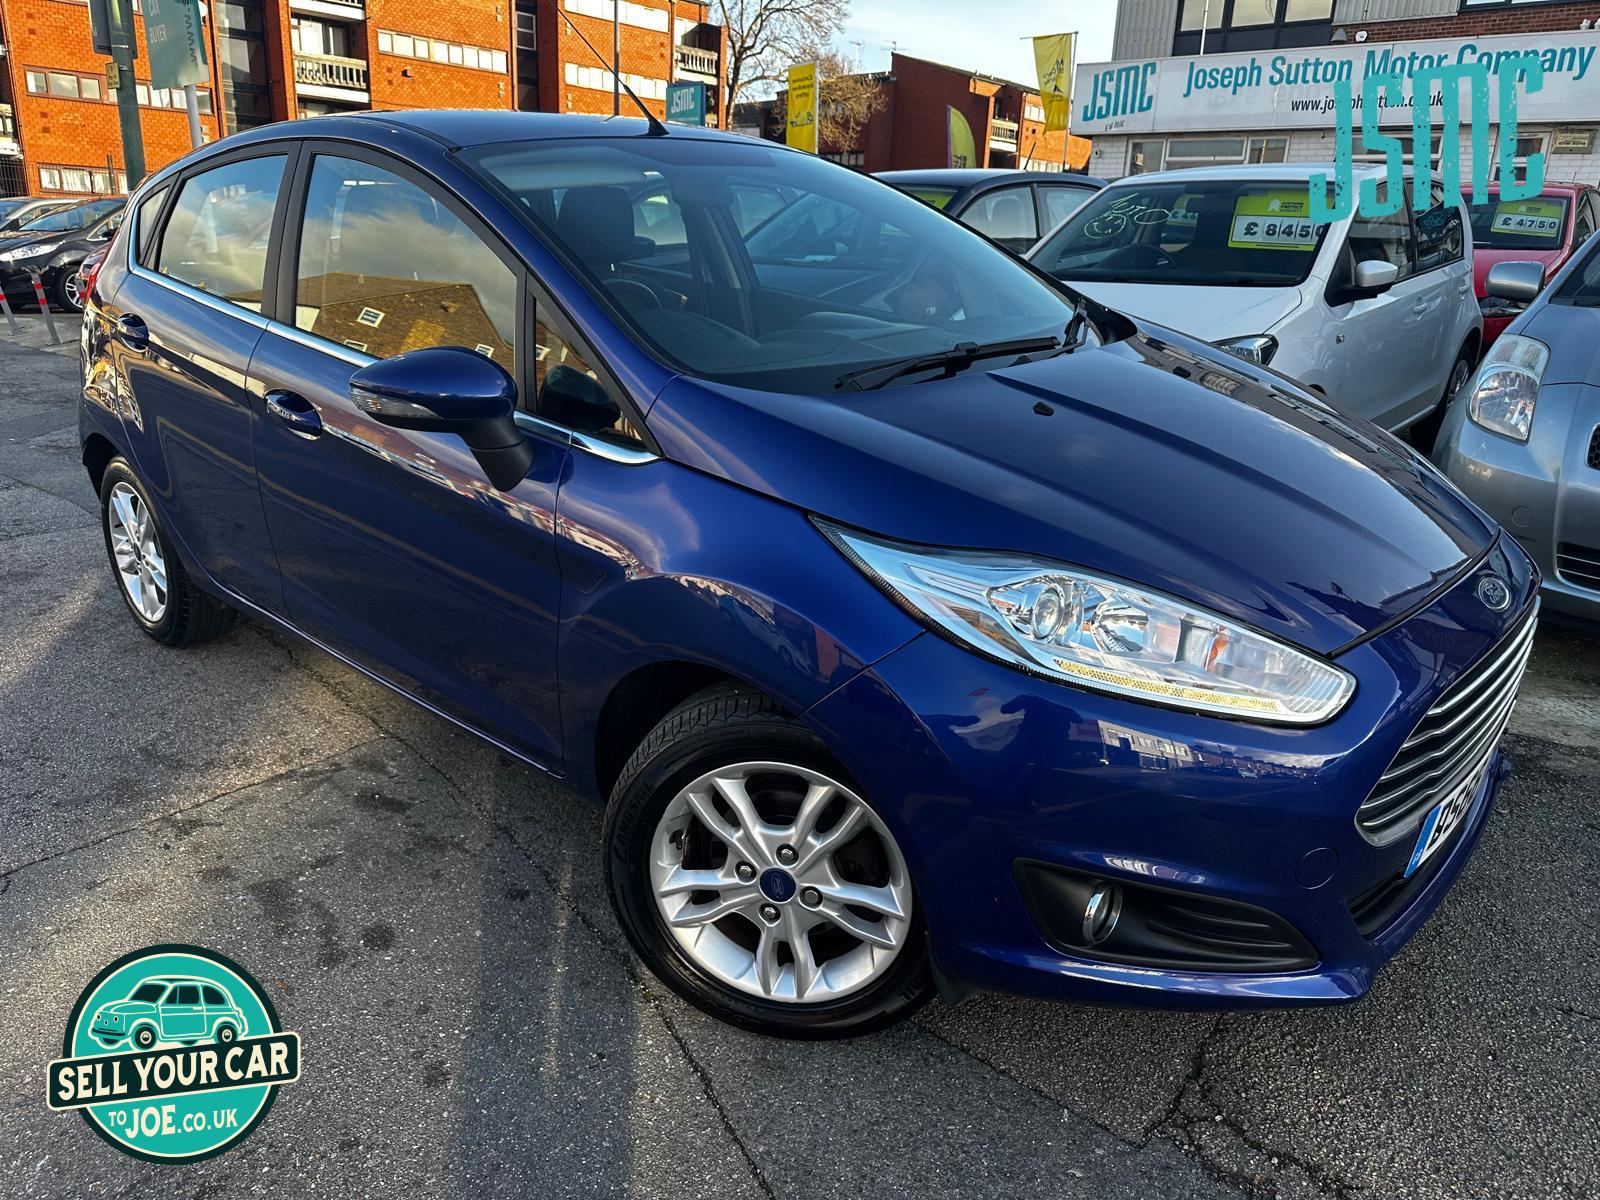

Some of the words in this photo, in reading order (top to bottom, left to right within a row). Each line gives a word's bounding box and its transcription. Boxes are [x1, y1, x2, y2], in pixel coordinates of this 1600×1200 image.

[1082, 61, 1157, 122] JSMC
[1183, 57, 1262, 98] Joseph
[1269, 55, 1353, 86] Sutton
[1363, 48, 1448, 81] Motor
[671, 87, 694, 114] JSMC
